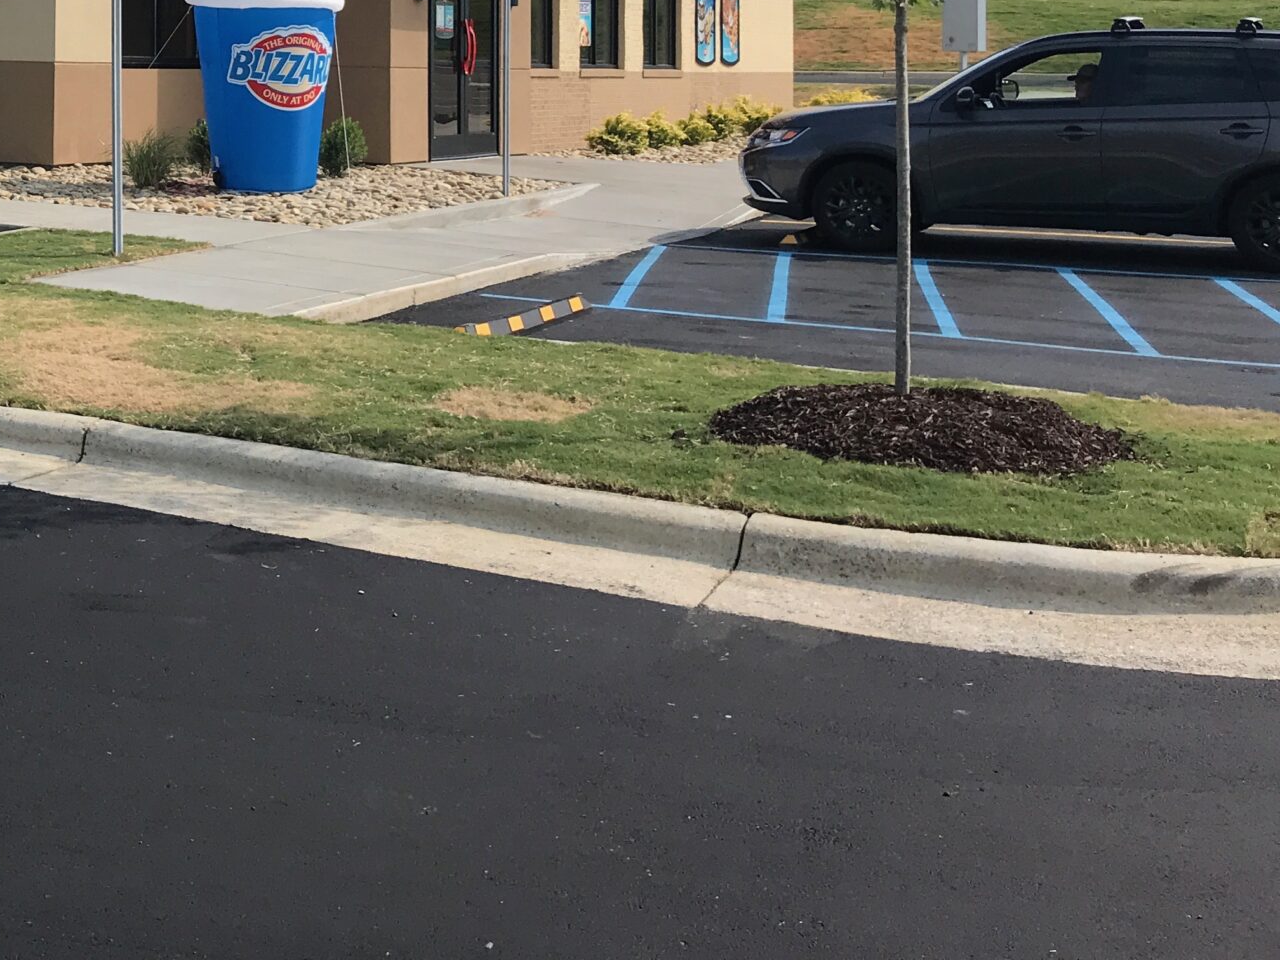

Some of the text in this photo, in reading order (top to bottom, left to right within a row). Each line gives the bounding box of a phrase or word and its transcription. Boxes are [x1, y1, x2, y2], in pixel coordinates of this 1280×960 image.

[263, 36, 323, 53] THE ORIGINAL
[263, 89, 288, 104] ONLY
[289, 96, 302, 105] AT
